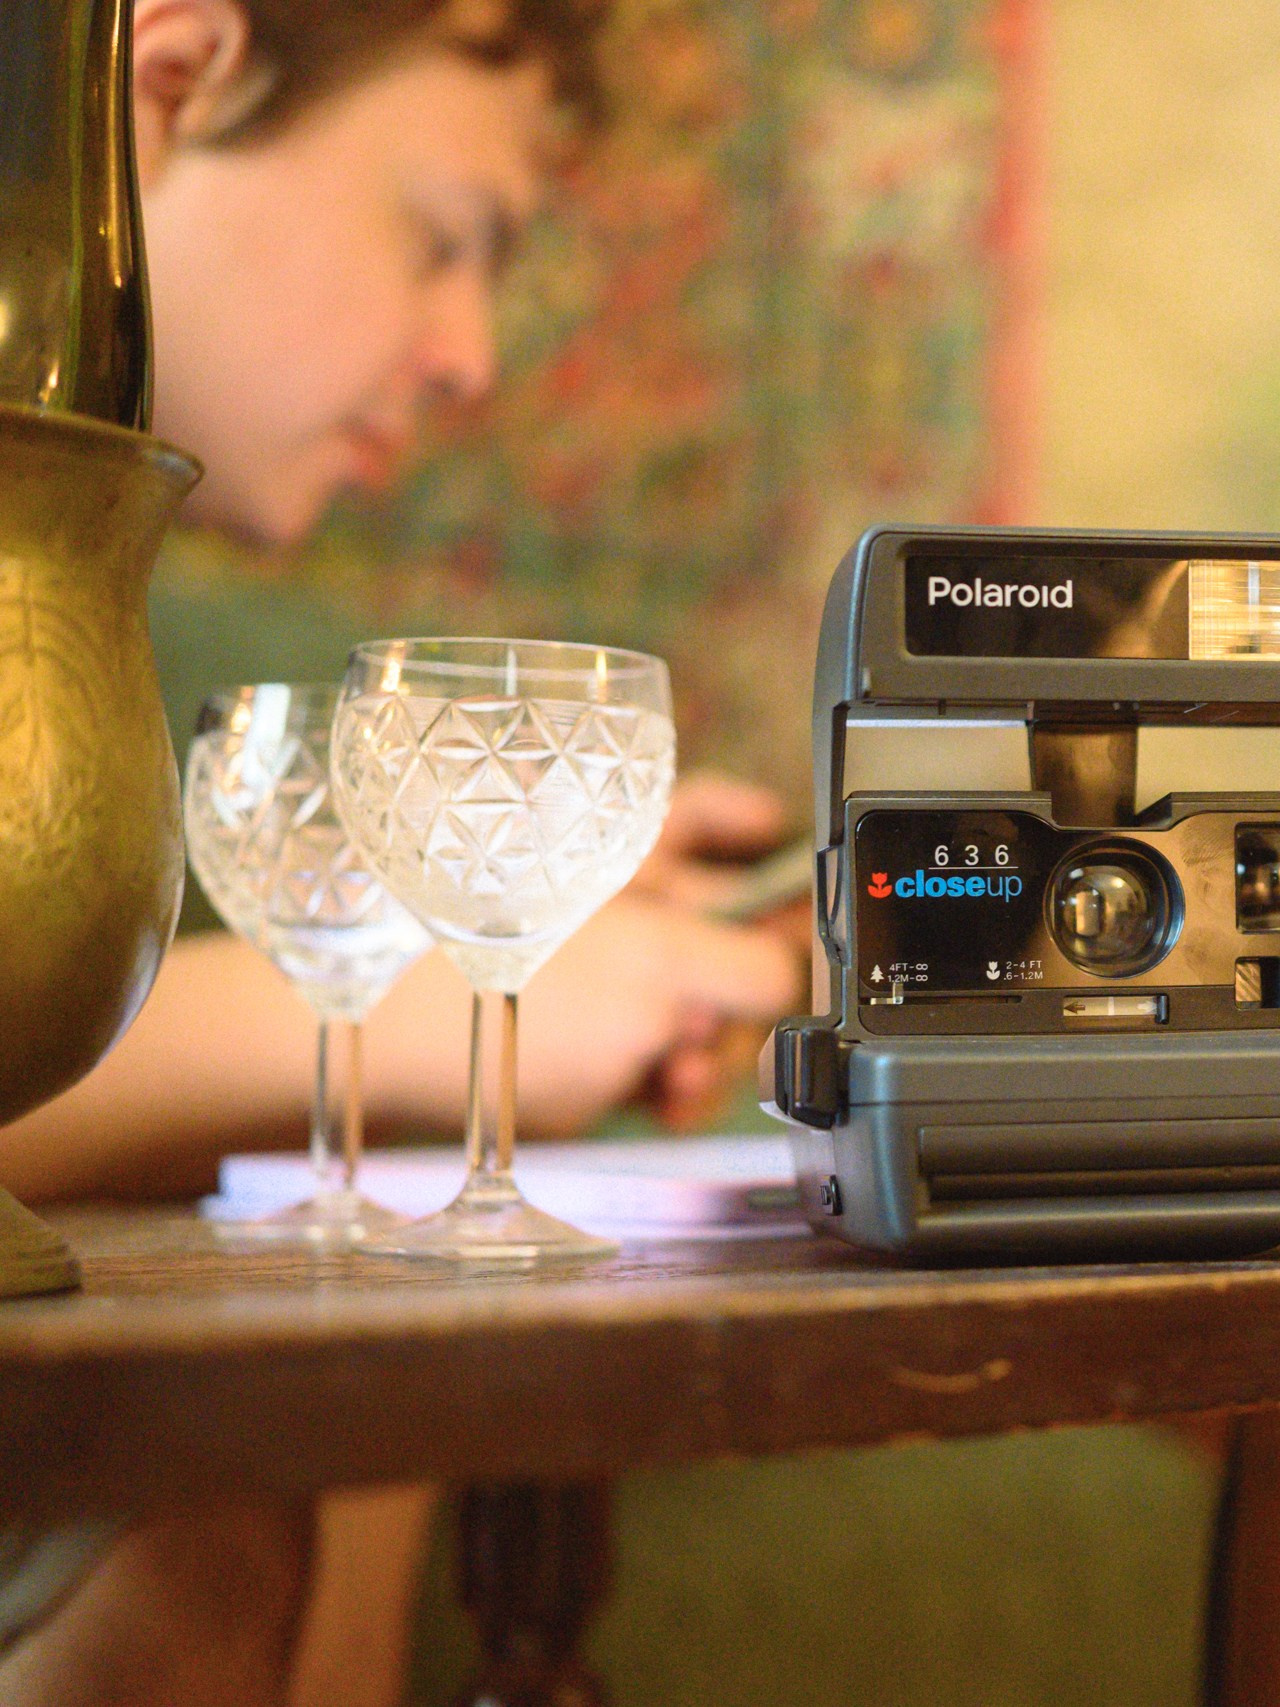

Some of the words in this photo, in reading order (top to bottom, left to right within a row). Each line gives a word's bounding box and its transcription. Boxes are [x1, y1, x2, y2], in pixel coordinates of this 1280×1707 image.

[928, 576, 1073, 608] Polaroid
[895, 869, 1023, 903] closeup
[1006, 961, 1026, 969] 2-4
[1029, 960, 1043, 969] FT
